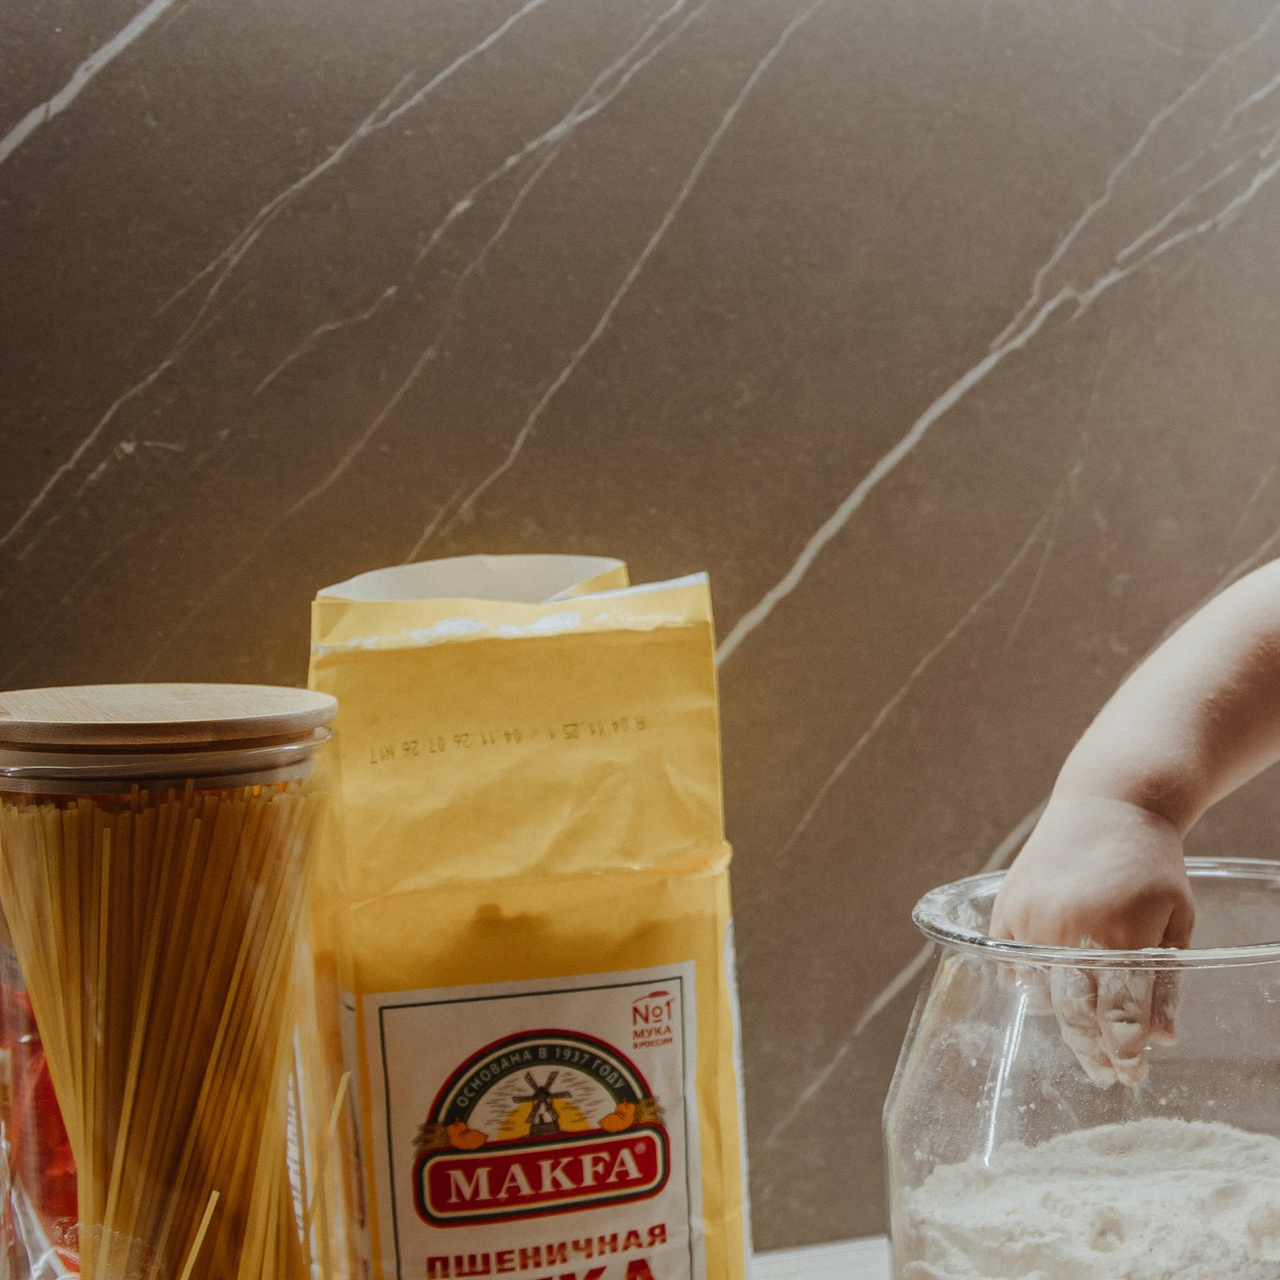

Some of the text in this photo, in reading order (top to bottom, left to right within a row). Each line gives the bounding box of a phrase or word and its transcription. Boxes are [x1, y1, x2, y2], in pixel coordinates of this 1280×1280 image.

[632, 1025, 672, 1039] МУКА
[456, 1047, 627, 1108] ОСНОВАНА В 1937 ГОДУ
[446, 1144, 643, 1203] MAKFA
[426, 1223, 668, 1280] ПШЕНИЧНАЯ
